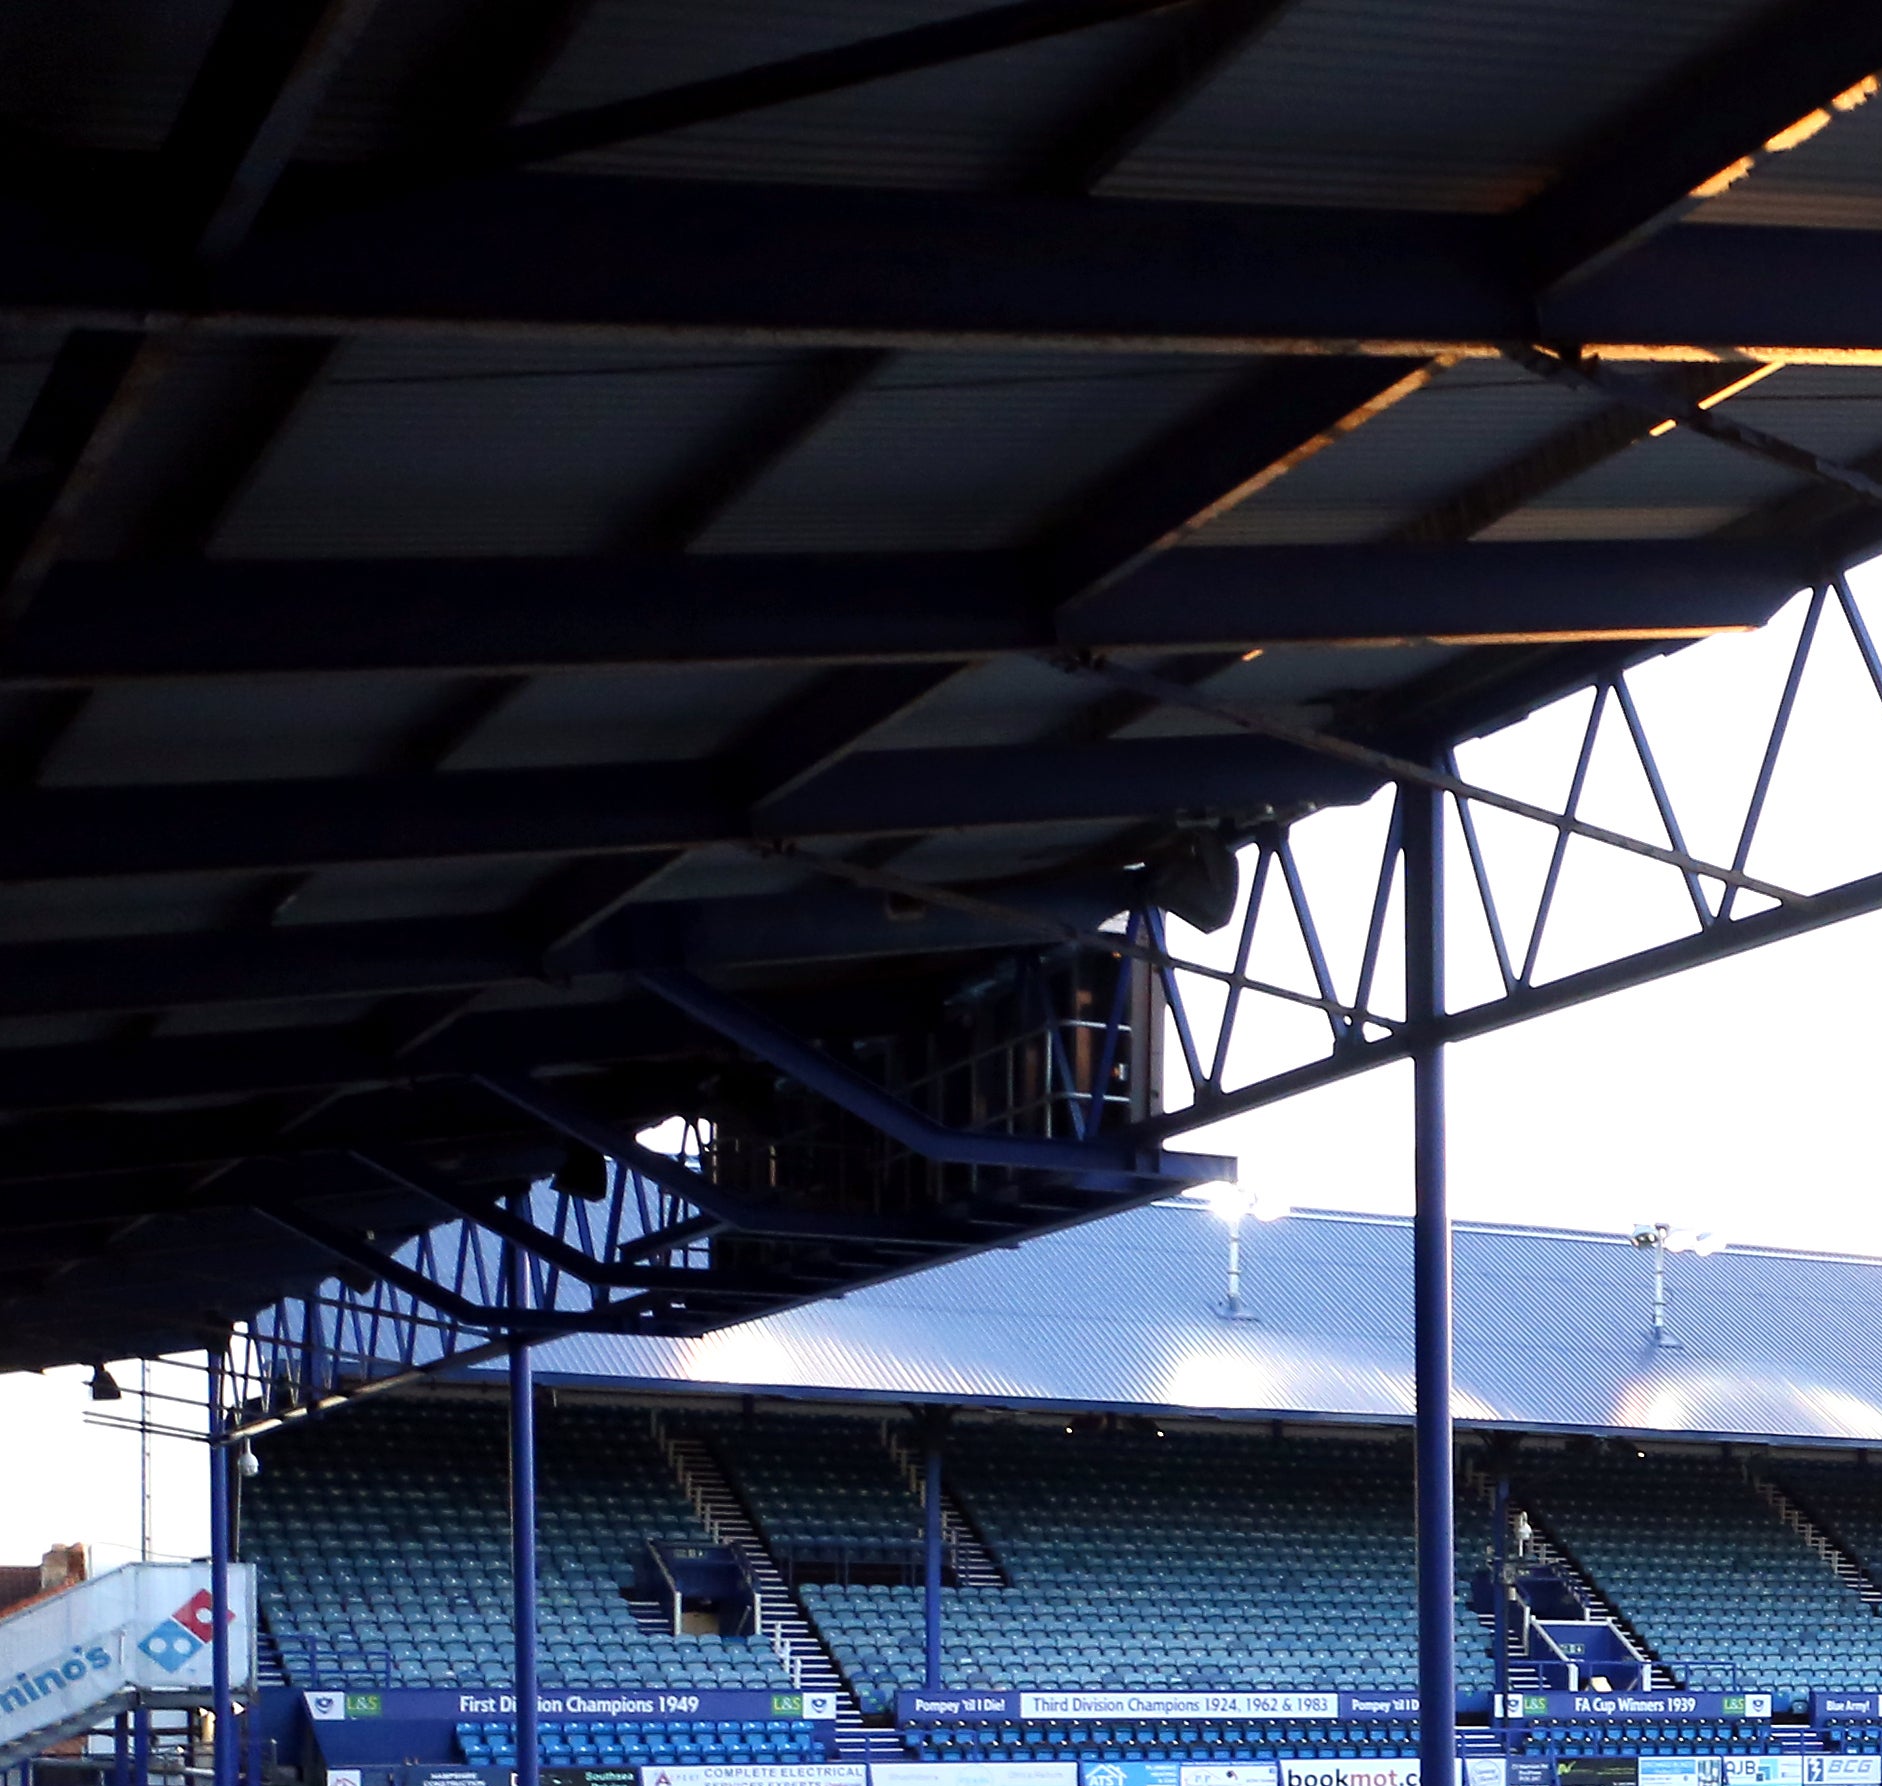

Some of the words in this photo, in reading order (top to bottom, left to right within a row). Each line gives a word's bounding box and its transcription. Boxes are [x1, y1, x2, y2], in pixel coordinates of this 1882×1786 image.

[460, 1695, 496, 1713] First
[566, 1696, 653, 1715] Champions
[659, 1696, 699, 1713] 1949
[773, 1696, 801, 1712] L&S
[915, 1699, 960, 1714] Pompey
[984, 1699, 1005, 1712] Die!
[1033, 1698, 1068, 1712] Third
[1072, 1698, 1123, 1712] Division
[1127, 1698, 1200, 1715] Champions
[1246, 1698, 1278, 1712] 1962
[1283, 1699, 1293, 1712] &
[1297, 1698, 1328, 1712] 1983
[1352, 1700, 1391, 1714] Pompey
[1523, 1697, 1545, 1711] L&S
[1575, 1698, 1590, 1712] FA
[1593, 1698, 1615, 1714] Cup
[1619, 1698, 1665, 1712] Winners
[1667, 1698, 1696, 1712] 1939
[1724, 1697, 1744, 1711] L&S
[1826, 1701, 1845, 1711] Blue
[1846, 1700, 1871, 1713] Army!
[704, 1768, 777, 1778] COMPLETE
[781, 1767, 863, 1777] ELECTRICAL
[1828, 1759, 1873, 1773] BCG
[585, 1771, 633, 1781] Southsea
